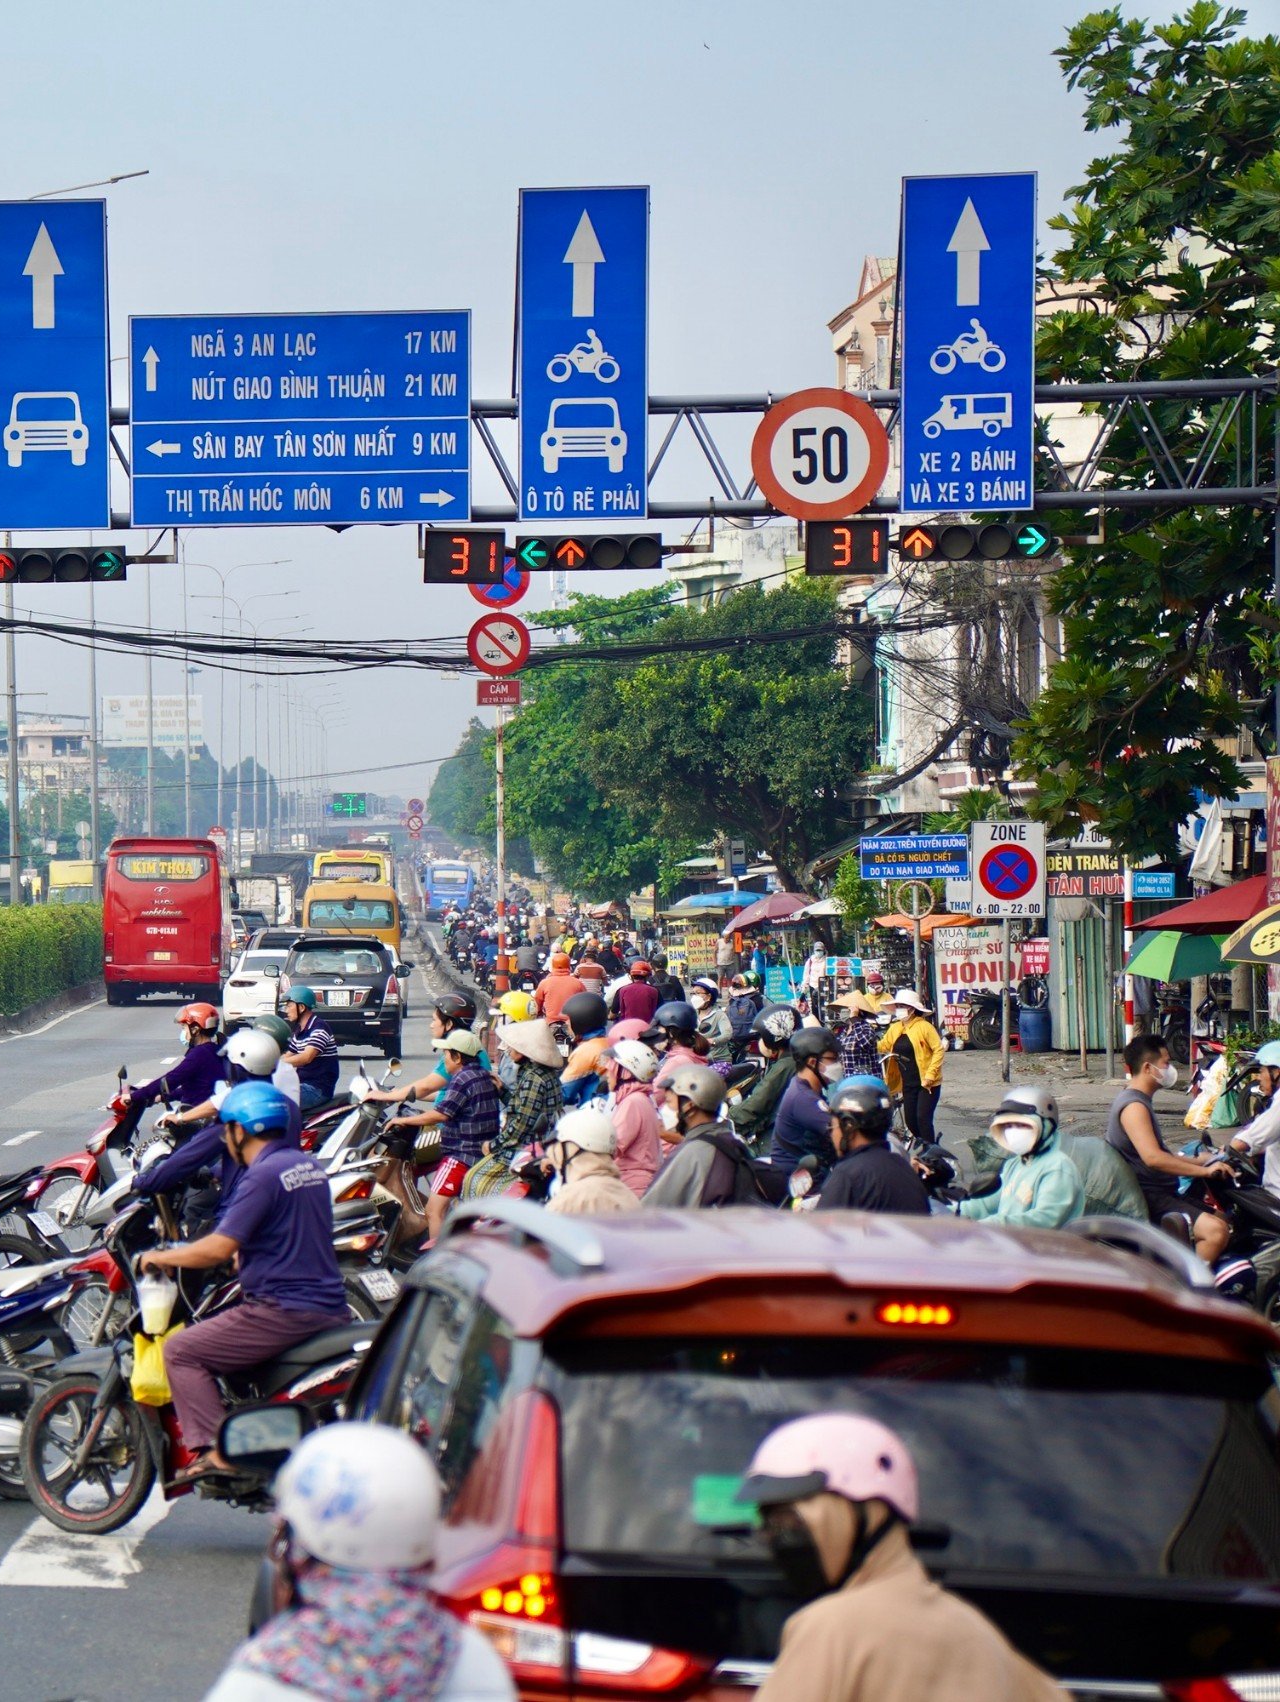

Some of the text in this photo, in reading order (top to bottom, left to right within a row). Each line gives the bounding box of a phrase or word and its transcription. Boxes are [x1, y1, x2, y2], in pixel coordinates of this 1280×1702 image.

[191, 329, 456, 361] NGÃ 3 AN LẠC 17 KM
[191, 368, 456, 402] NÚT GIAO BÌNH THUẬN 21 KM
[193, 425, 456, 459] SÂN BAY TÂN SƠN NHẤT 9 KM
[792, 426, 848, 485] 50
[920, 446, 1016, 473] XE 2 BÁNH
[166, 481, 403, 517] THỊ TRẤN HÓC MÔN 6 KM
[527, 483, 640, 512] Ô TÔ RẼ PHẢI
[910, 476, 1025, 503] VÀ XE 3 BÁNH
[450, 537, 497, 576] 31
[832, 527, 880, 566] 31
[490, 682, 509, 694] CẤM
[863, 839, 879, 850] NĂM
[918, 836, 941, 848] TUYẾN
[943, 837, 966, 848] ĐƯỜNG
[991, 825, 1026, 840] ZONE
[132, 861, 193, 874] KIM THOA
[875, 850, 952, 863] ĐÃ CÓ 15 NGƯỜI CHẾT
[1047, 853, 1072, 871] ĐÈN
[1076, 855, 1118, 870] TRANG
[870, 864, 960, 876] DO TAI NẠN GIAO THÔNG
[1047, 873, 1125, 896] TÂN HƯN
[950, 901, 971, 910] THAY
[937, 941, 950, 949] XE
[939, 929, 963, 938] MUA
[1026, 954, 1046, 963] XE MÁY
[941, 961, 1024, 984] HOND
